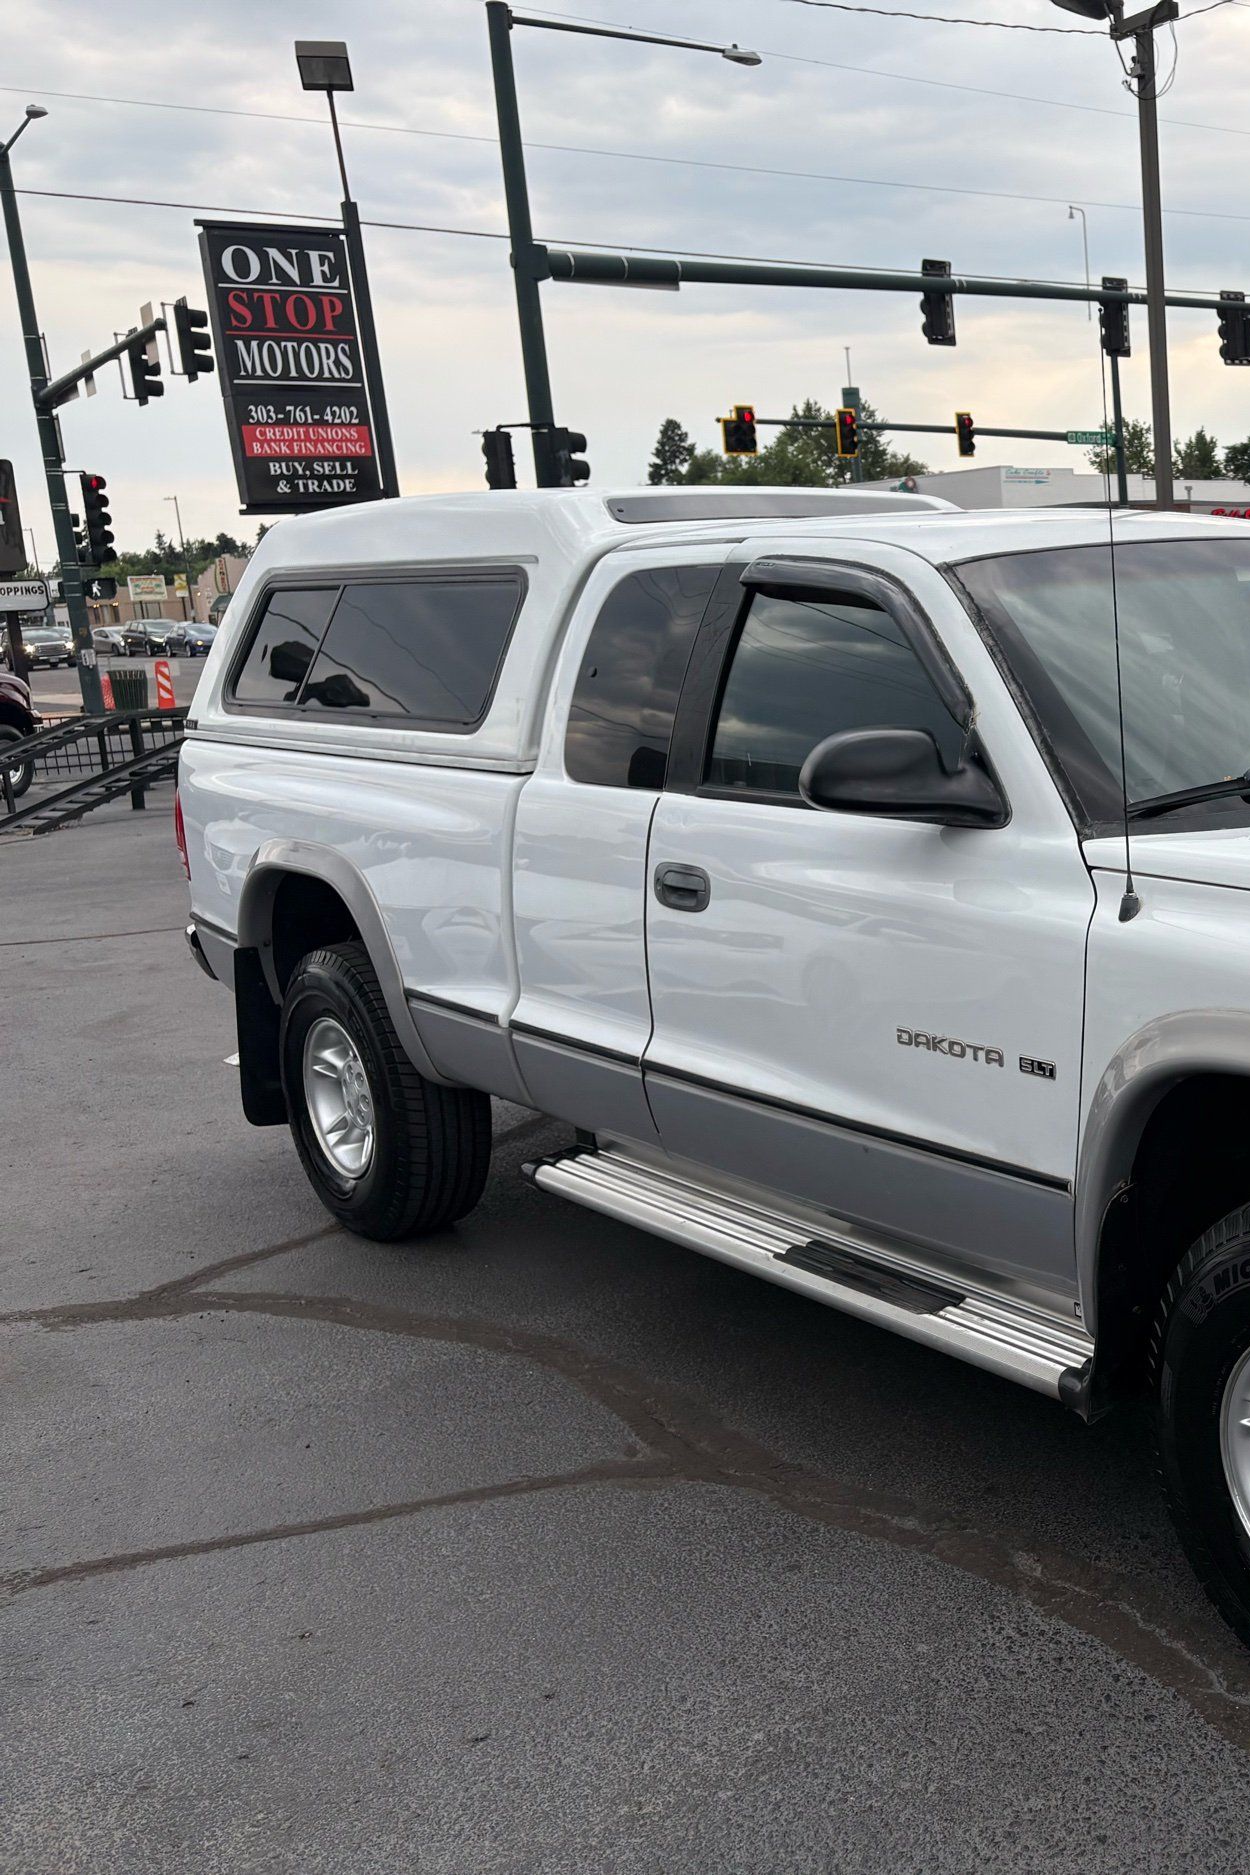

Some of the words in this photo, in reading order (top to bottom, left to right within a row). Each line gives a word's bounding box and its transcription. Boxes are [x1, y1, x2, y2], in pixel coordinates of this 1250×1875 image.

[221, 245, 340, 288] ONE
[227, 290, 343, 331] STOP
[234, 340, 353, 380] MOTORS
[247, 405, 359, 424] 303-761-4202
[255, 427, 306, 440] CREDIT
[308, 427, 358, 440] UNIONS
[1077, 432, 1101, 443] Oxford
[253, 442, 291, 454] BANK
[293, 442, 365, 454] FINANCING
[268, 461, 310, 477] BUY,
[313, 461, 358, 475] SELL
[276, 480, 291, 493] &
[294, 479, 356, 493] TRADE
[896, 1026, 1004, 1067] DAKOTA
[1020, 1059, 1053, 1077] SLT
